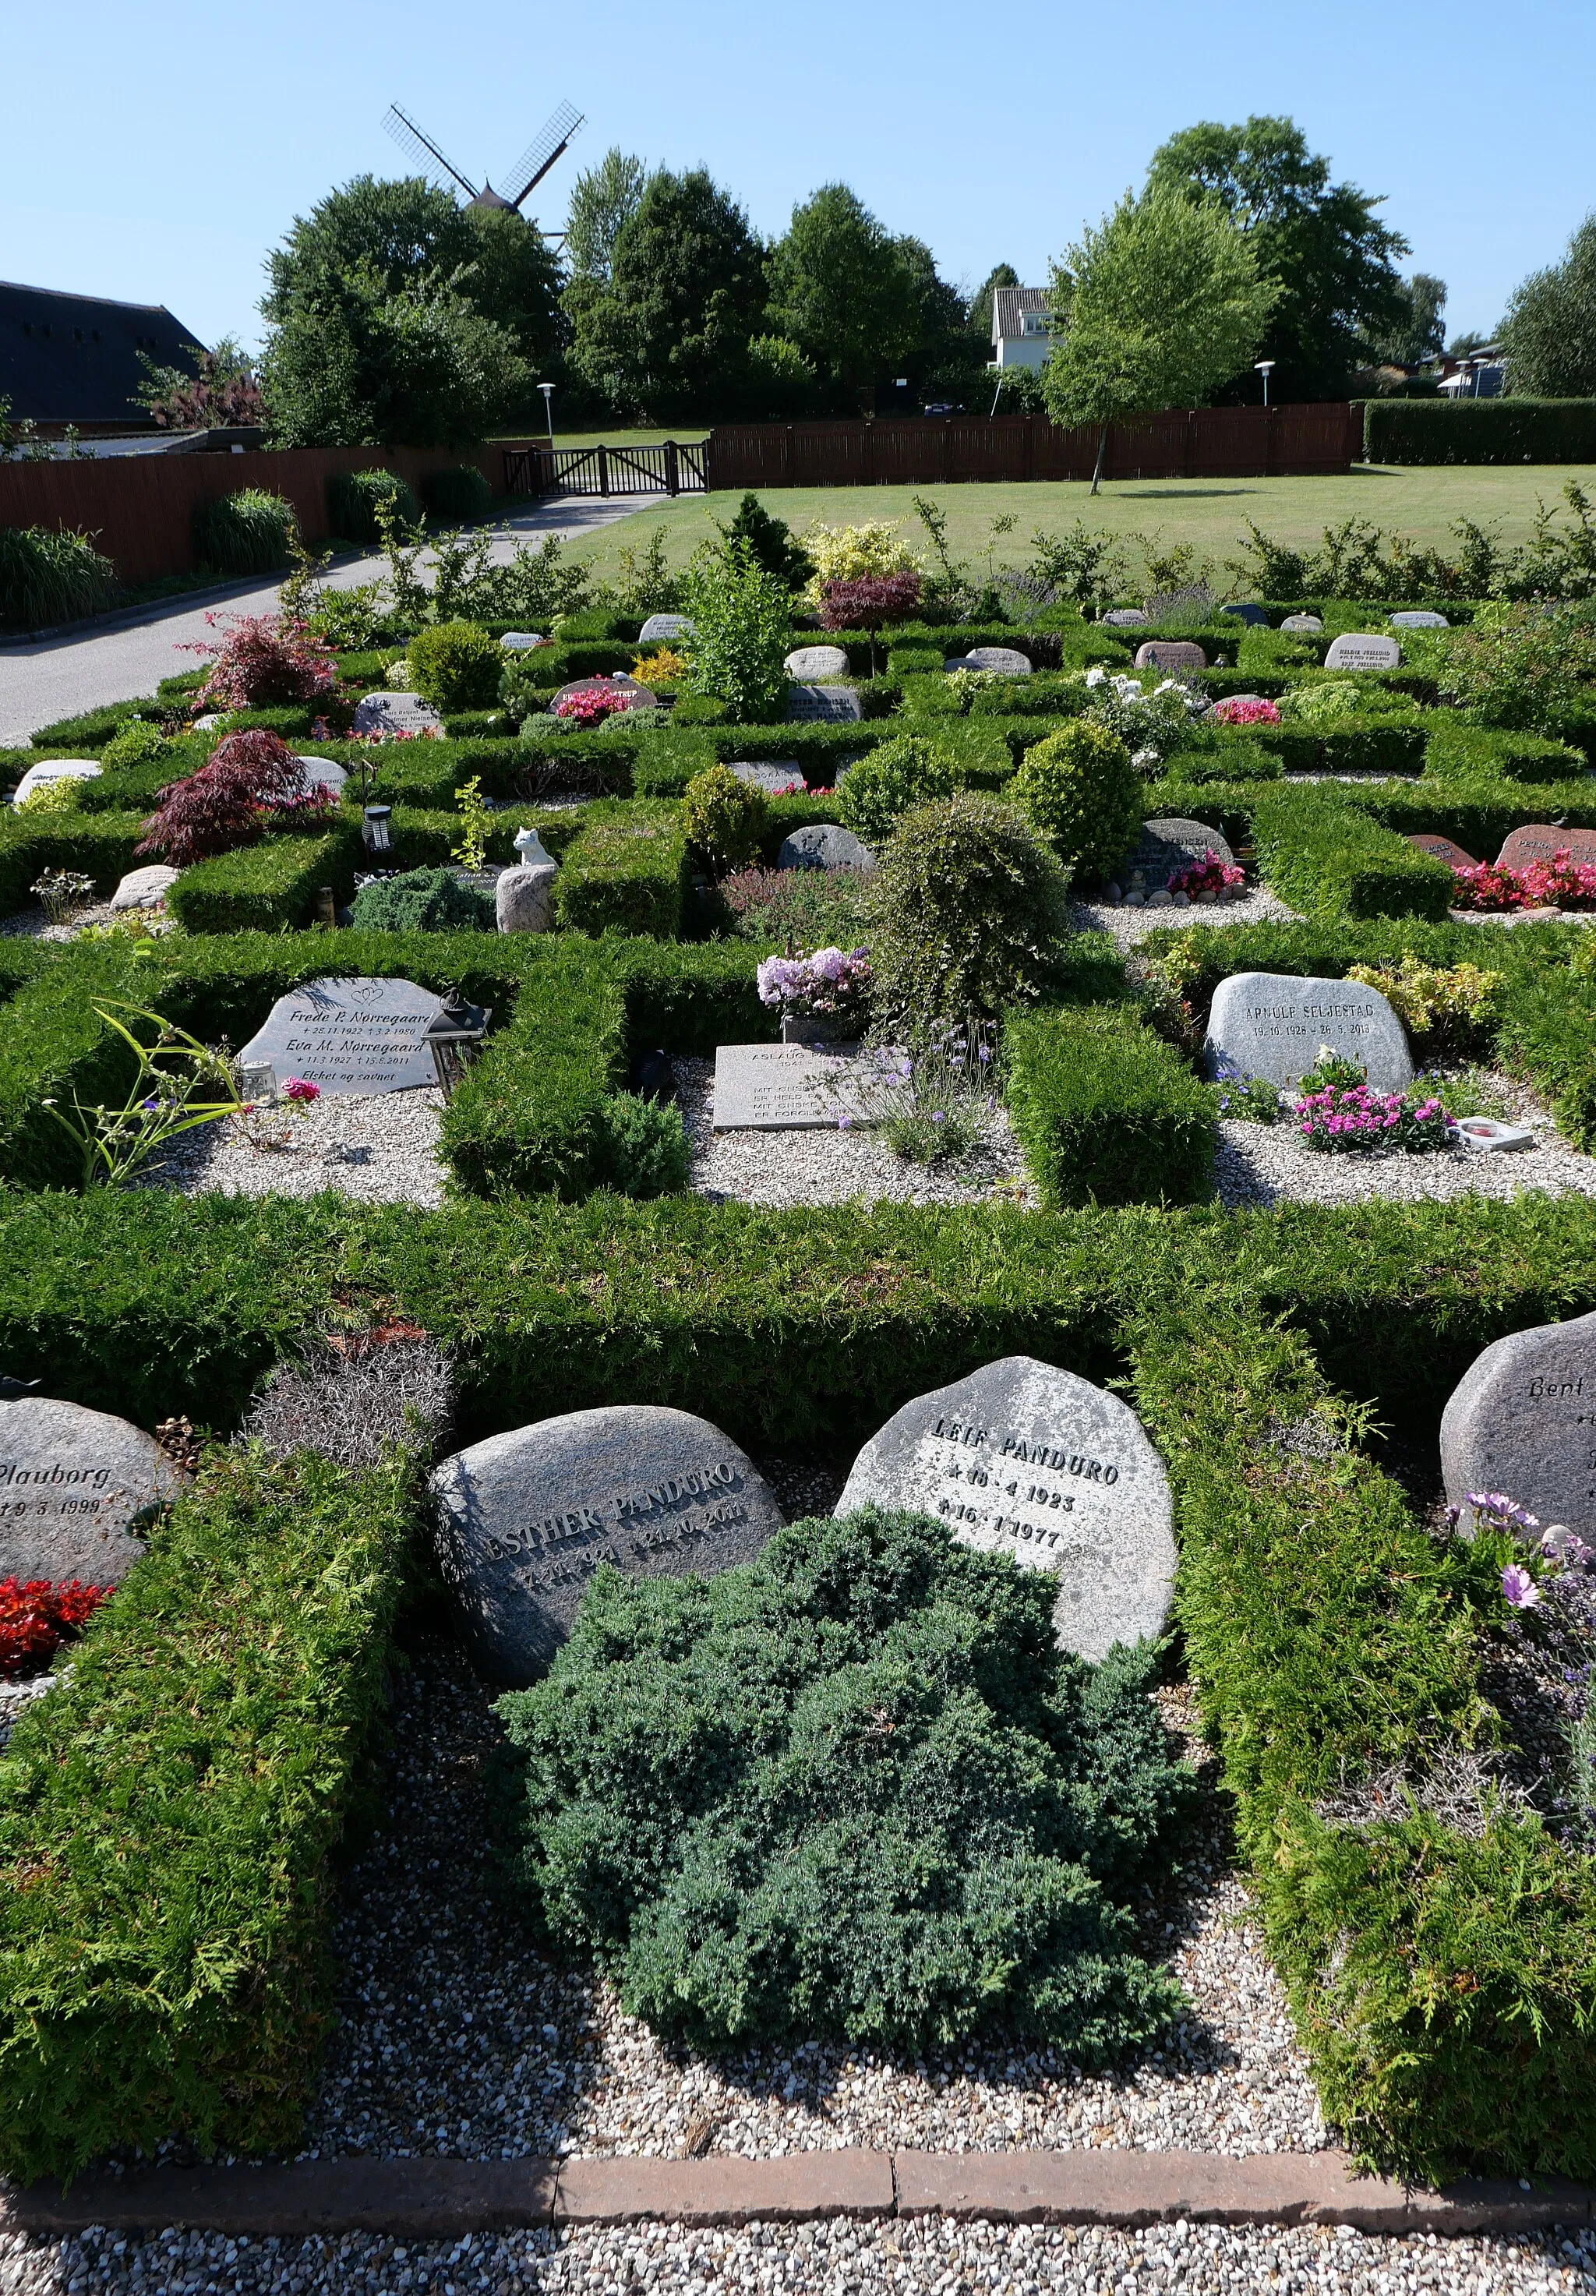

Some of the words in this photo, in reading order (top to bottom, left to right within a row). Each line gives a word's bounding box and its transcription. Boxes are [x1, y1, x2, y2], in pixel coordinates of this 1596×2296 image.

[289, 1009, 330, 1023] Frede
[335, 1011, 344, 1023] P.
[1246, 1006, 1296, 1020] ARNULF
[1303, 1004, 1375, 1018] SELJESTAD
[1286, 1025, 1307, 1036] 1928
[285, 1039, 312, 1051] Eva
[316, 1040, 334, 1051] M.
[339, 1040, 425, 1054] Nørregaard
[752, 1052, 805, 1061] ASLAUG
[302, 1070, 337, 1081] Elsket
[340, 1073, 355, 1083] og
[357, 1072, 395, 1082] savnet
[1529, 1376, 1584, 1398] Bent
[930, 1417, 990, 1449] LEIF
[998, 1436, 1121, 1486] PANDURO
[1026, 1484, 1076, 1513] 1923
[483, 1506, 602, 1563] ESTHER
[609, 1461, 736, 1521] PANDURO
[704, 1501, 745, 1528] 2011
[1008, 1520, 1061, 1549] 1977
